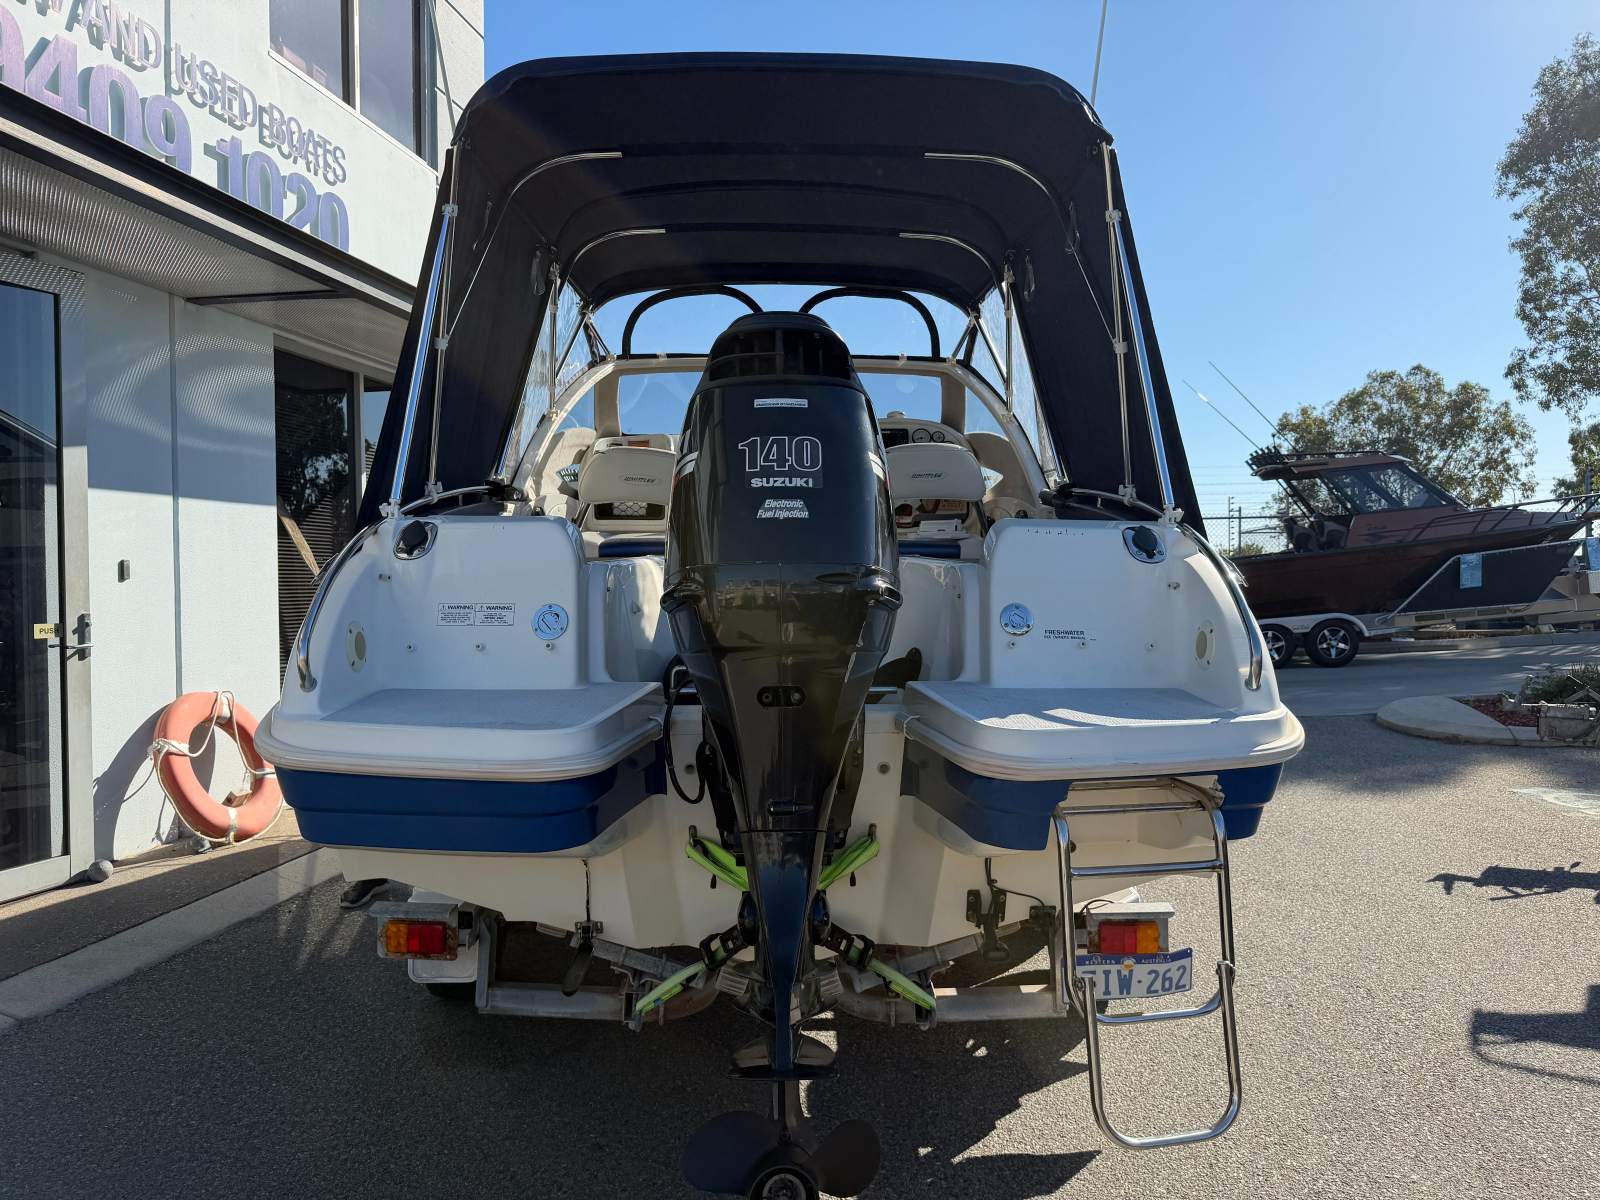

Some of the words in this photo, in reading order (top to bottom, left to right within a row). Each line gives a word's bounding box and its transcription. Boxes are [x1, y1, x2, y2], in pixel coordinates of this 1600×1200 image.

[80, 0, 162, 69] AND
[175, 43, 258, 128] USED
[266, 102, 347, 185] BOATS
[215, 134, 350, 253] 1020
[738, 436, 822, 471] 140
[750, 477, 813, 488] SUZUKI
[764, 499, 804, 508] Electronic
[757, 508, 775, 518] Fuel
[774, 508, 809, 519] Injection
[39, 627, 60, 635] PUSH
